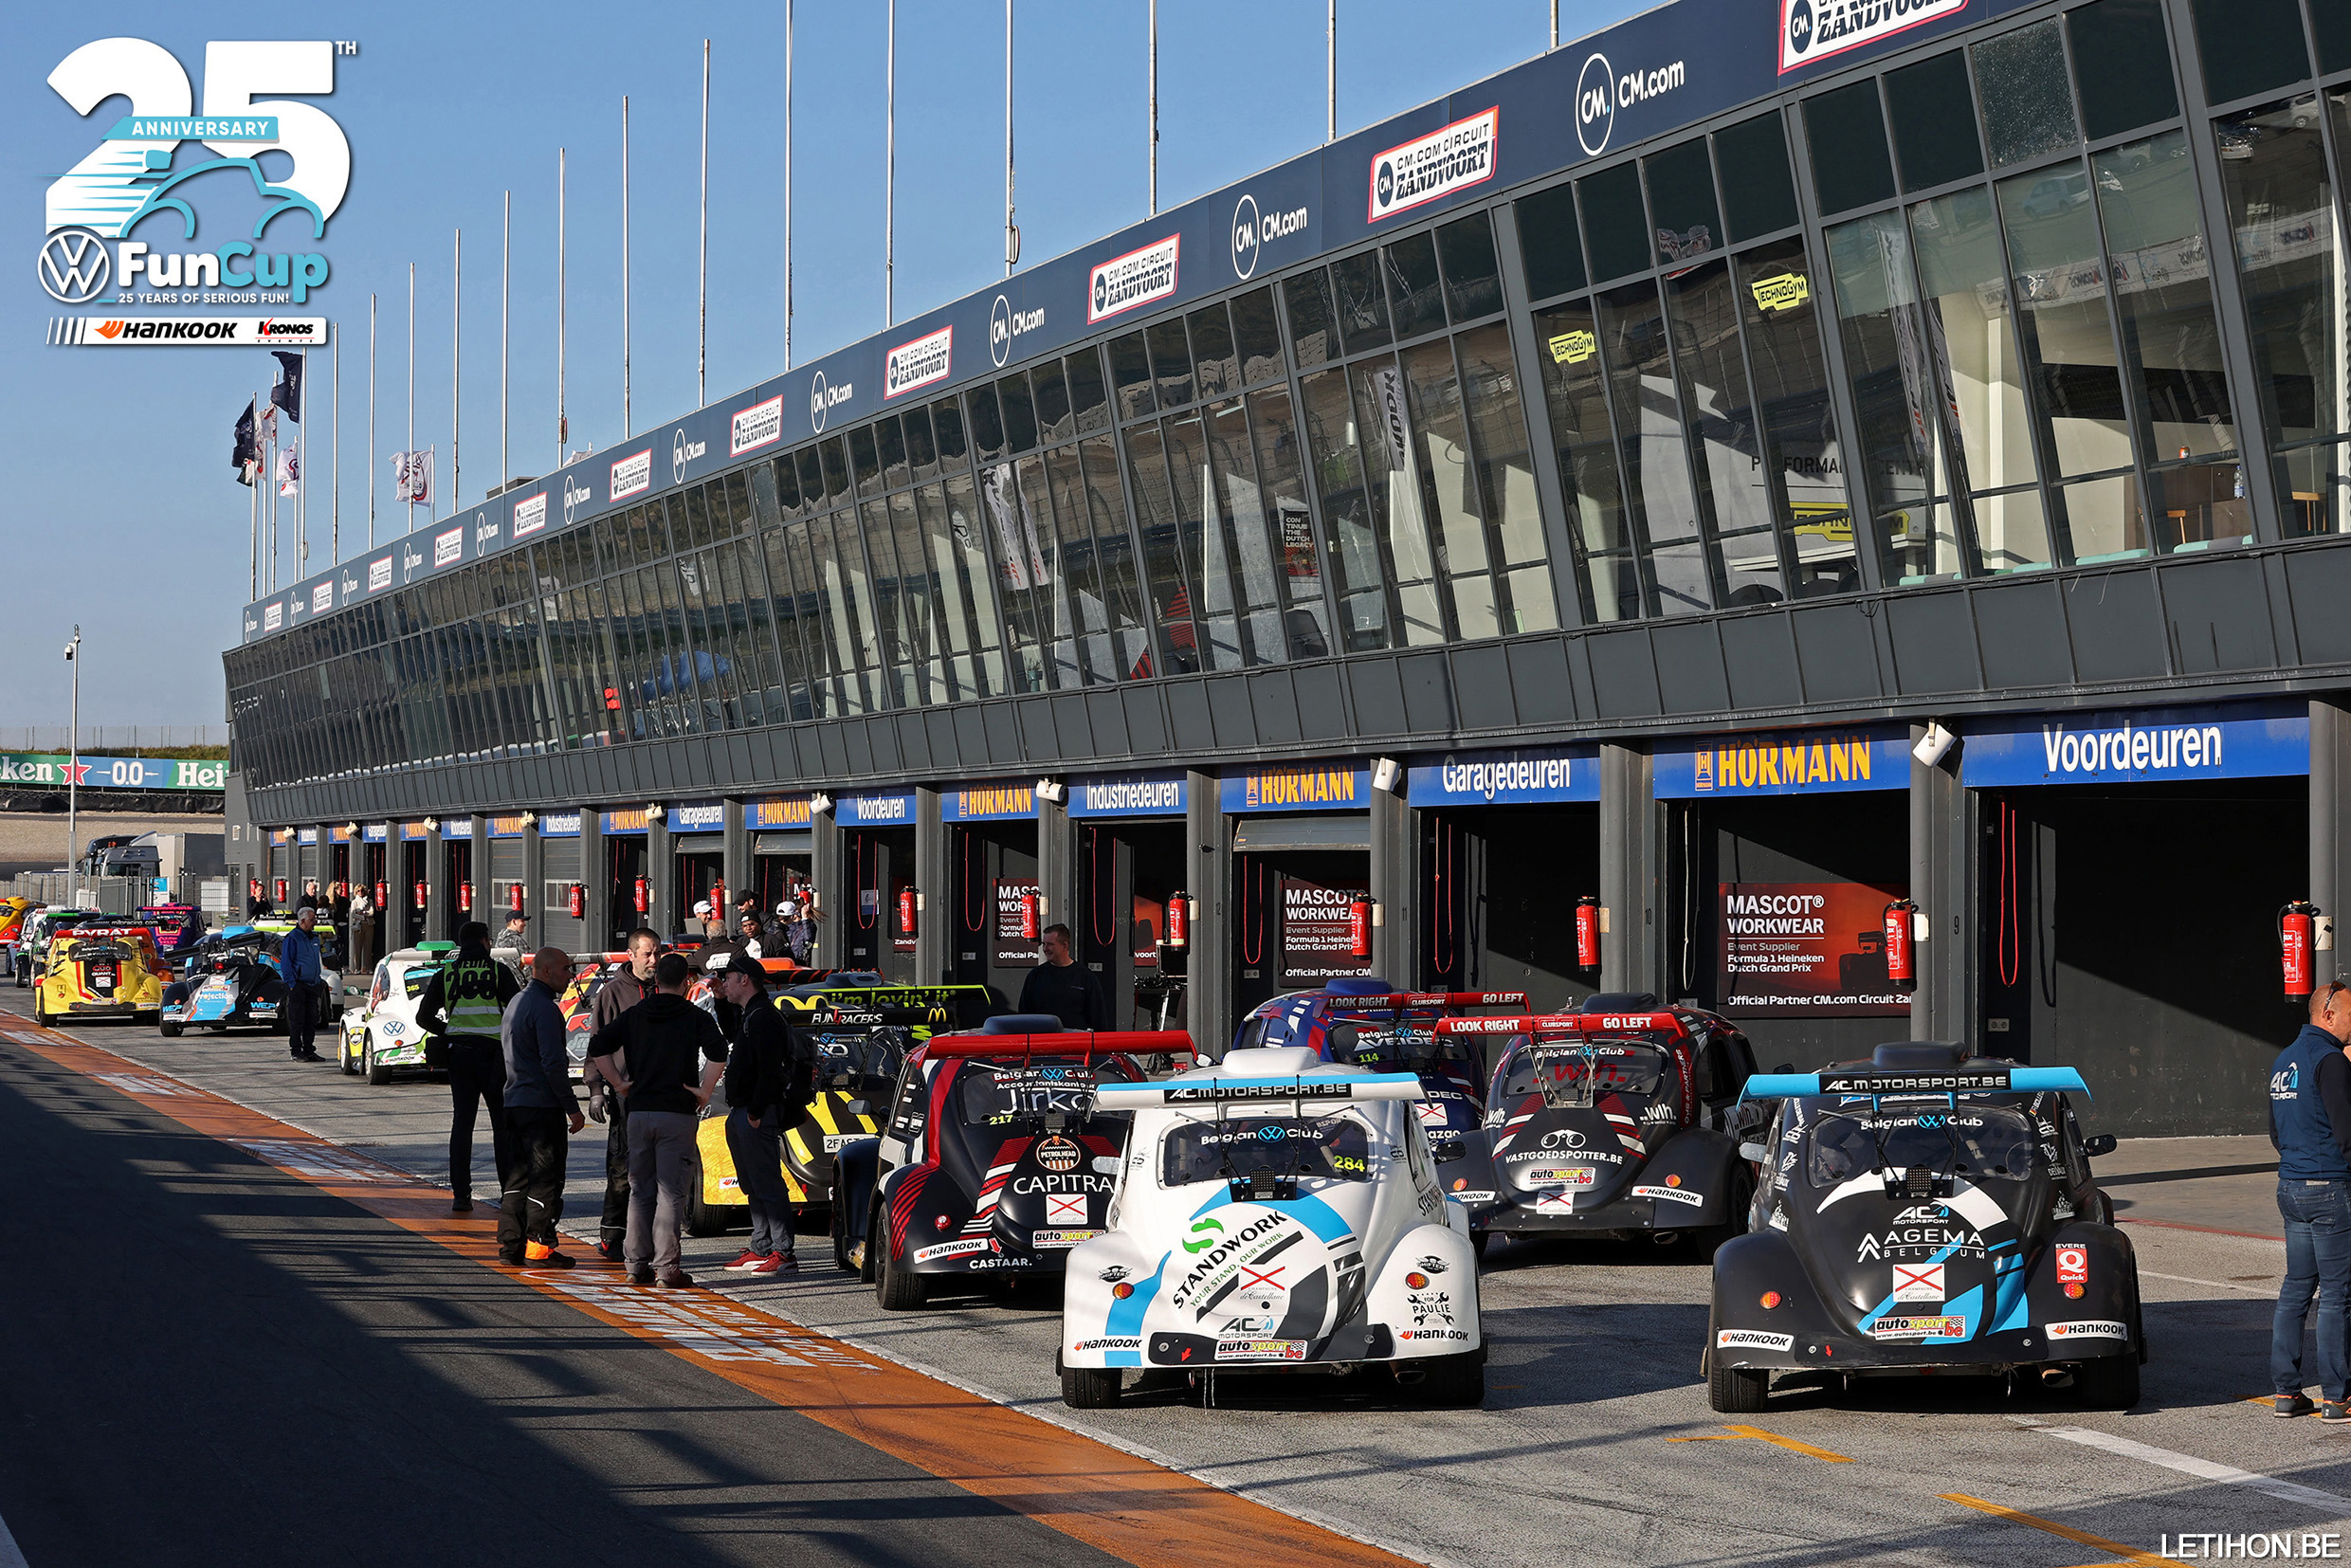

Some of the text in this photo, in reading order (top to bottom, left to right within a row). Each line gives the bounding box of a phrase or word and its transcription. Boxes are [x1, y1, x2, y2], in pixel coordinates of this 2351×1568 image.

[1618, 60, 1685, 108] CM.com
[1397, 123, 1489, 171] CM.COM CIRCUIT
[1395, 140, 1488, 200] ZANDVOORT
[1262, 206, 1307, 243] CM.com
[1108, 247, 1174, 283] CM.COM CIRCUIT
[1107, 262, 1173, 307] ZANDVOORT
[1011, 307, 1045, 336] CM.com
[828, 382, 852, 406] CM.com
[2044, 722, 2222, 772] Voordeuren
[1719, 735, 1870, 787] HÖRMANN
[112, 760, 143, 786] 0.0
[1442, 755, 1570, 799] Garagedeuren
[1086, 776, 1179, 811] Industriedeuren
[856, 793, 904, 820] Voordeuren
[1312, 926, 1346, 935] Supplier
[1727, 918, 1824, 934] WORKWEAR
[1727, 942, 1800, 952] Event Supplier
[1727, 955, 1824, 963] Formula 1 Heineken
[1727, 963, 1812, 973] Dutch Grand Prix
[1285, 968, 1355, 977] Official Partner
[1330, 997, 1357, 1007] LOOK
[1358, 996, 1390, 1006] RIGHT
[1482, 994, 1496, 1004] GO
[1498, 993, 1522, 1003] LEFT
[1728, 994, 1894, 1006] Official Partner CM.com Circuit
[1450, 1021, 1484, 1032] LOOK
[1484, 1019, 1520, 1031] RIGHT
[1602, 1018, 1620, 1029] GO
[1622, 1017, 1652, 1029] LEFT
[1358, 1052, 1379, 1063] 114
[990, 1115, 1013, 1125] 217
[1201, 1128, 1323, 1145] Belgian Club
[1333, 1155, 1365, 1172] 284
[1505, 1150, 1623, 1165] VASTGOEDSPOTTER.BE
[1884, 1229, 1984, 1247] AGEMA
[1173, 1211, 1287, 1309] STANDWORK
[1884, 1248, 1985, 1259] BELGIUM
[1190, 1285, 1212, 1307] YOUR
[1239, 1247, 1258, 1263] OUR
[1257, 1232, 1284, 1249] WORK
[1412, 1304, 1450, 1314] PAULIE
